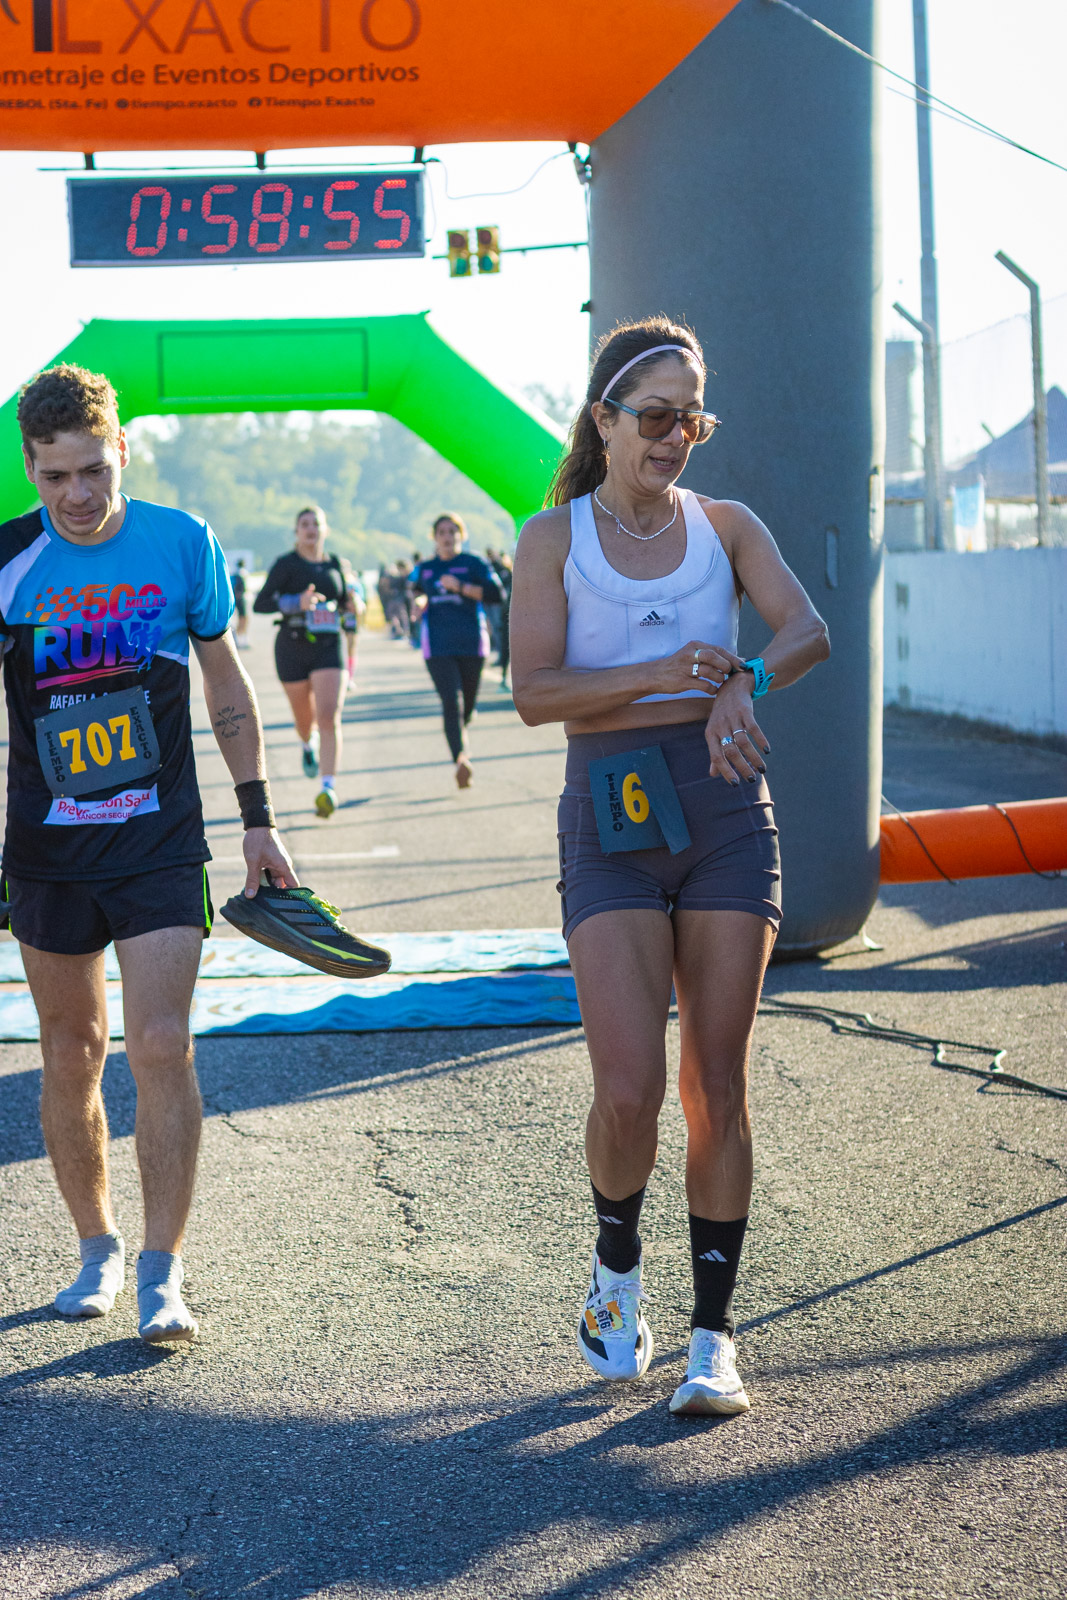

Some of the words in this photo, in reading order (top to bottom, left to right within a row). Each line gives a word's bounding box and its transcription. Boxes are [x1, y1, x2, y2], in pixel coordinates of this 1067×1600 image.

[0, 65, 104, 90] metraje
[112, 64, 145, 85] de
[153, 63, 261, 86] Eventos
[269, 62, 420, 87] Deportivos
[126, 179, 411, 256] 0:58:55
[125, 597, 167, 609] MILLAS
[34, 621, 149, 674] RUN
[44, 731, 66, 782] TIEMPO
[59, 714, 137, 774] 707
[129, 706, 152, 759] EXACTO
[604, 772, 624, 832] TIEMPO
[597, 1310, 611, 1330] 616
